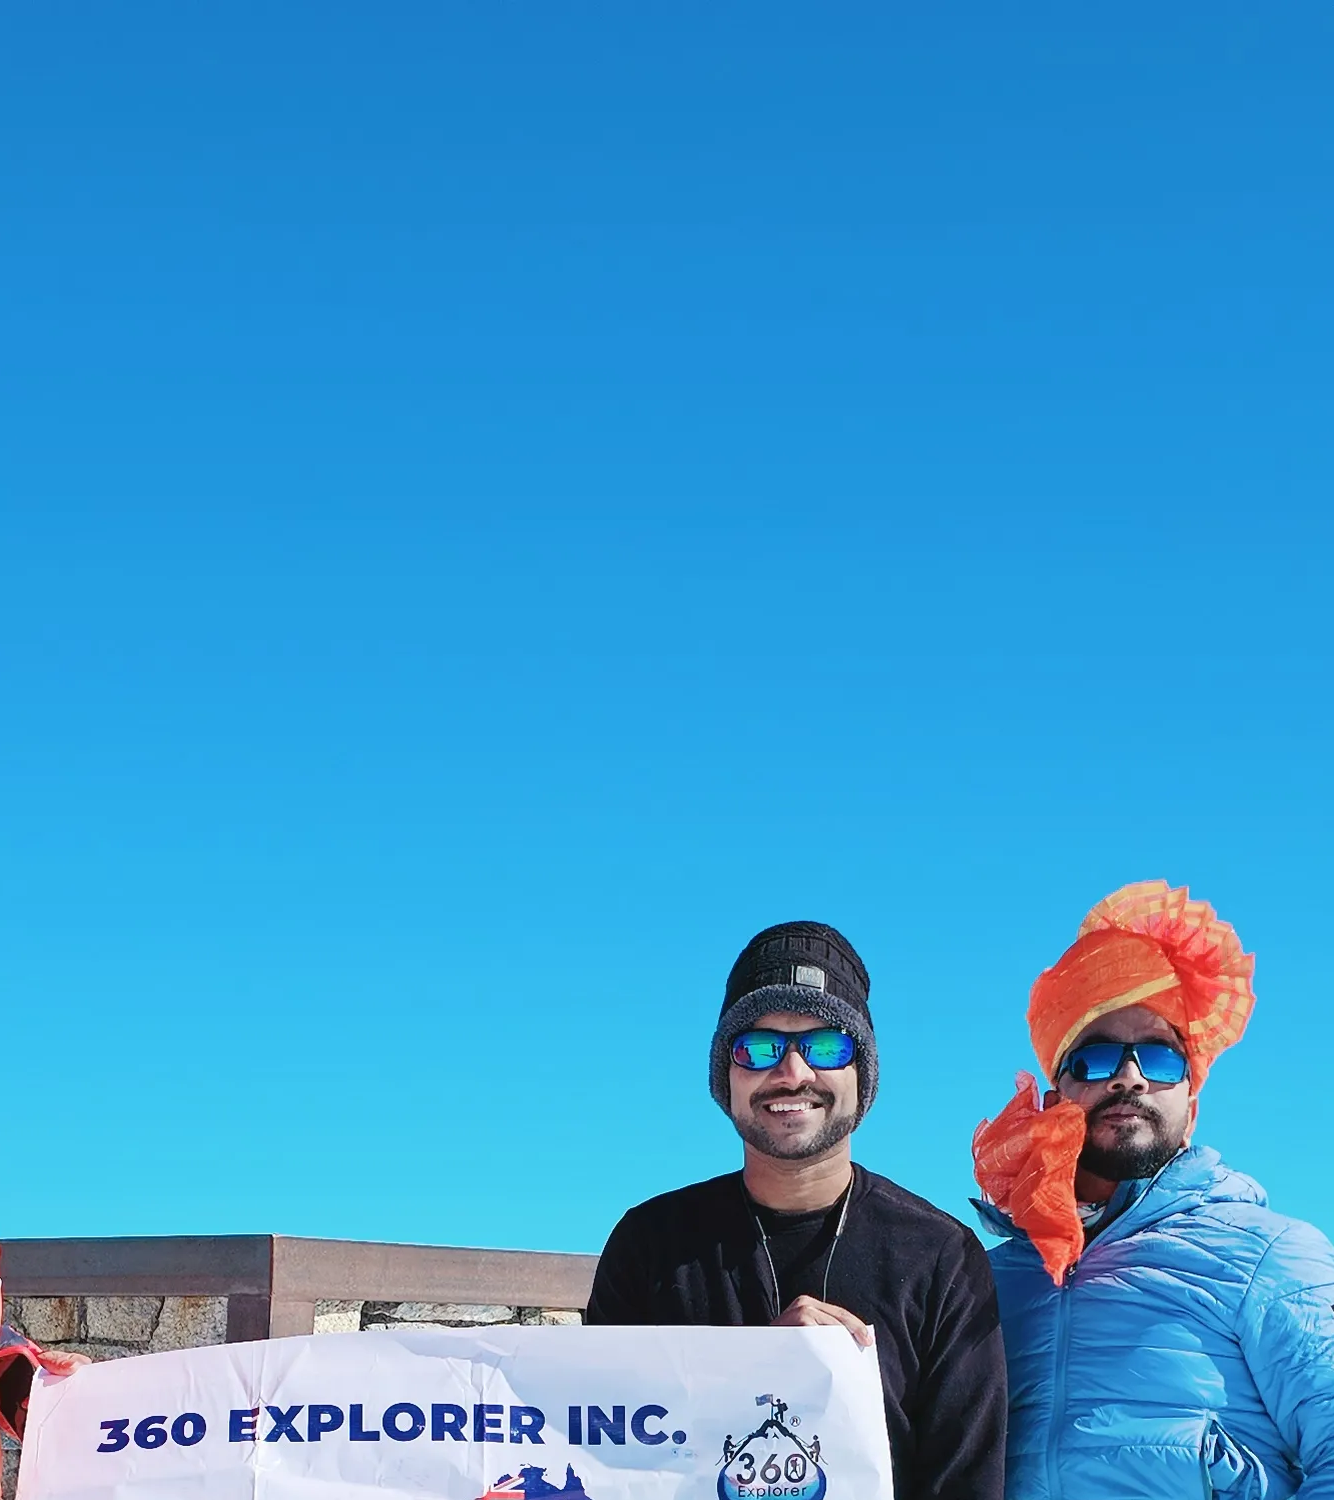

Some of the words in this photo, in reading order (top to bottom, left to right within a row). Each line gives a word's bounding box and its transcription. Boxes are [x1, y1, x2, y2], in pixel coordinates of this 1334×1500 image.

[97, 1413, 207, 1453] 360
[228, 1403, 546, 1445] EXPLORER
[569, 1405, 687, 1446] INC.
[736, 1452, 807, 1485] 360
[738, 1485, 807, 1499] Explorer
